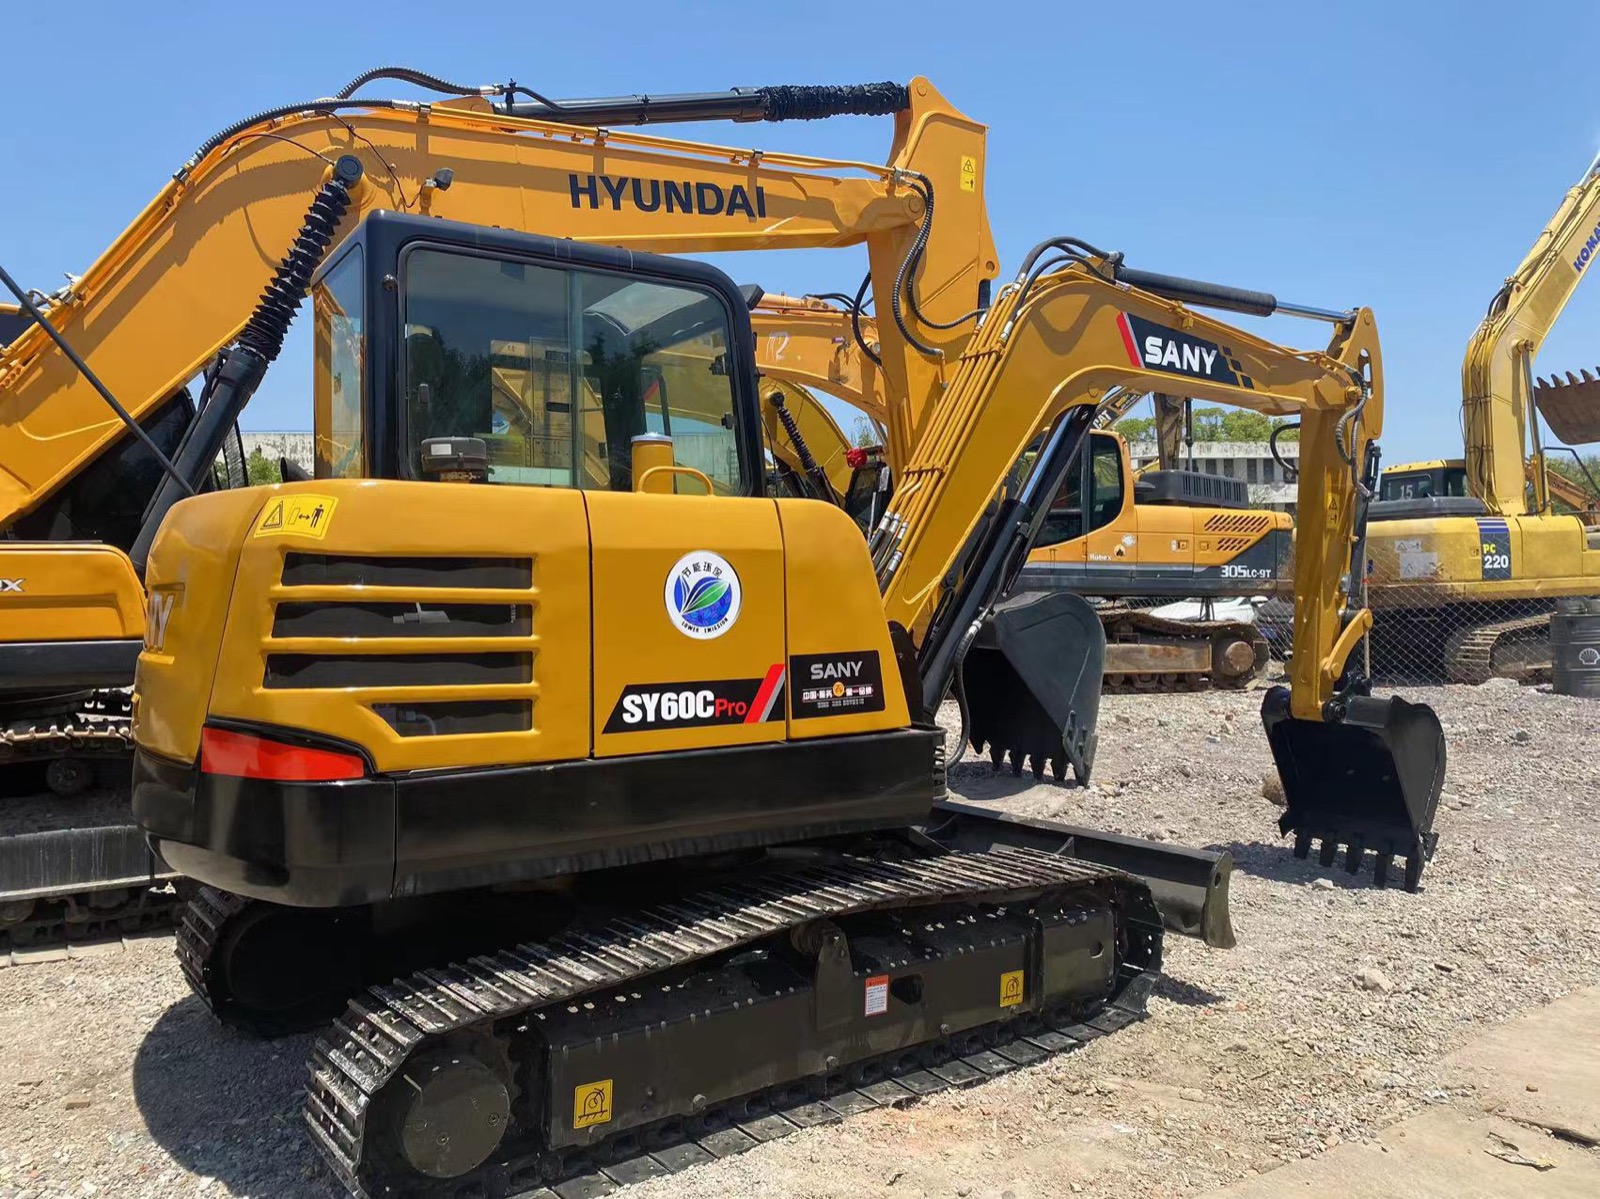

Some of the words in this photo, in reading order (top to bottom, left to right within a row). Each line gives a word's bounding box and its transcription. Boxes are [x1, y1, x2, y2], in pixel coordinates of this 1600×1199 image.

[569, 174, 766, 218] HYUNDAI
[1145, 336, 1218, 375] SANY
[1093, 409, 1112, 430] CAT
[1400, 484, 1413, 500] 15
[1483, 544, 1496, 554] PC
[1484, 555, 1509, 569] 220
[810, 660, 863, 680] SANY
